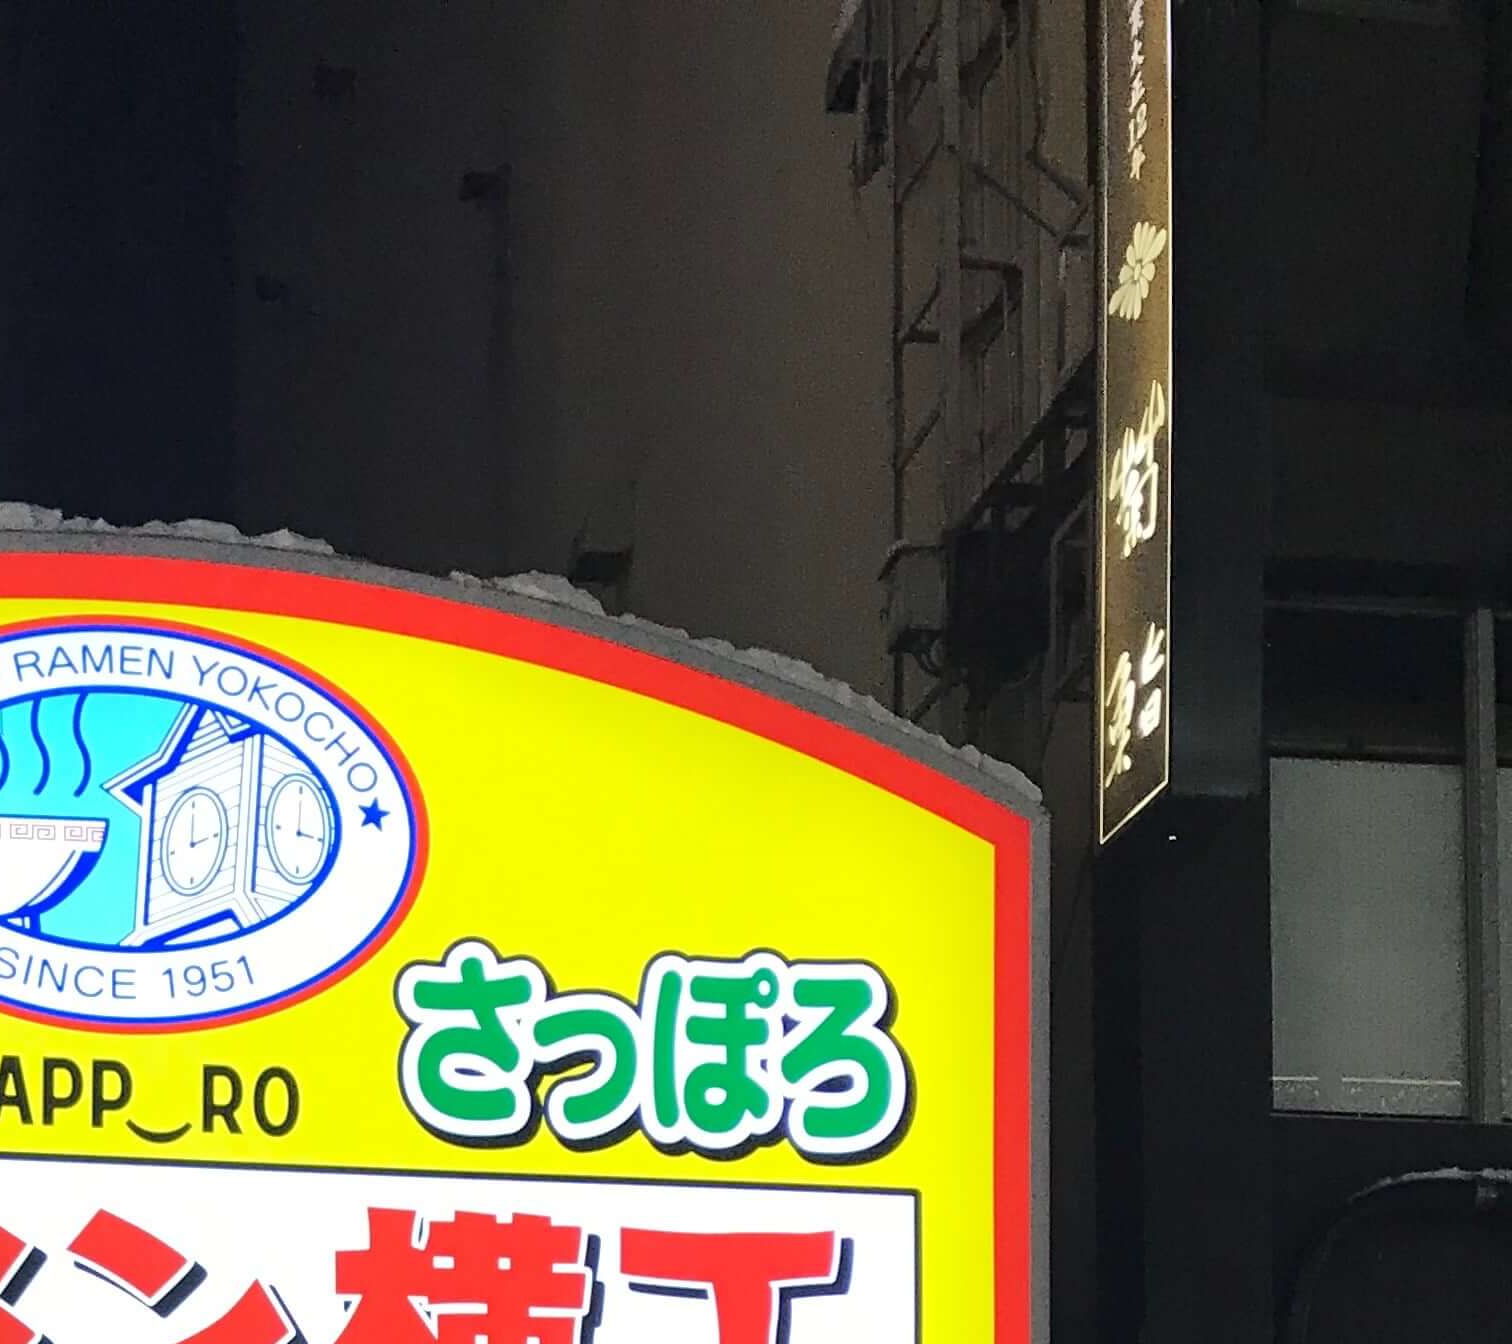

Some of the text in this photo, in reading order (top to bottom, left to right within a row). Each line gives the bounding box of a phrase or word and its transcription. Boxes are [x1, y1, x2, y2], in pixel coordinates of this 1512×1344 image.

[14, 643, 175, 683] RAMEN
[193, 654, 378, 794] YOKOCHO
[164, 955, 255, 1000] 1951
[398, 942, 910, 1158] さっぽろ
